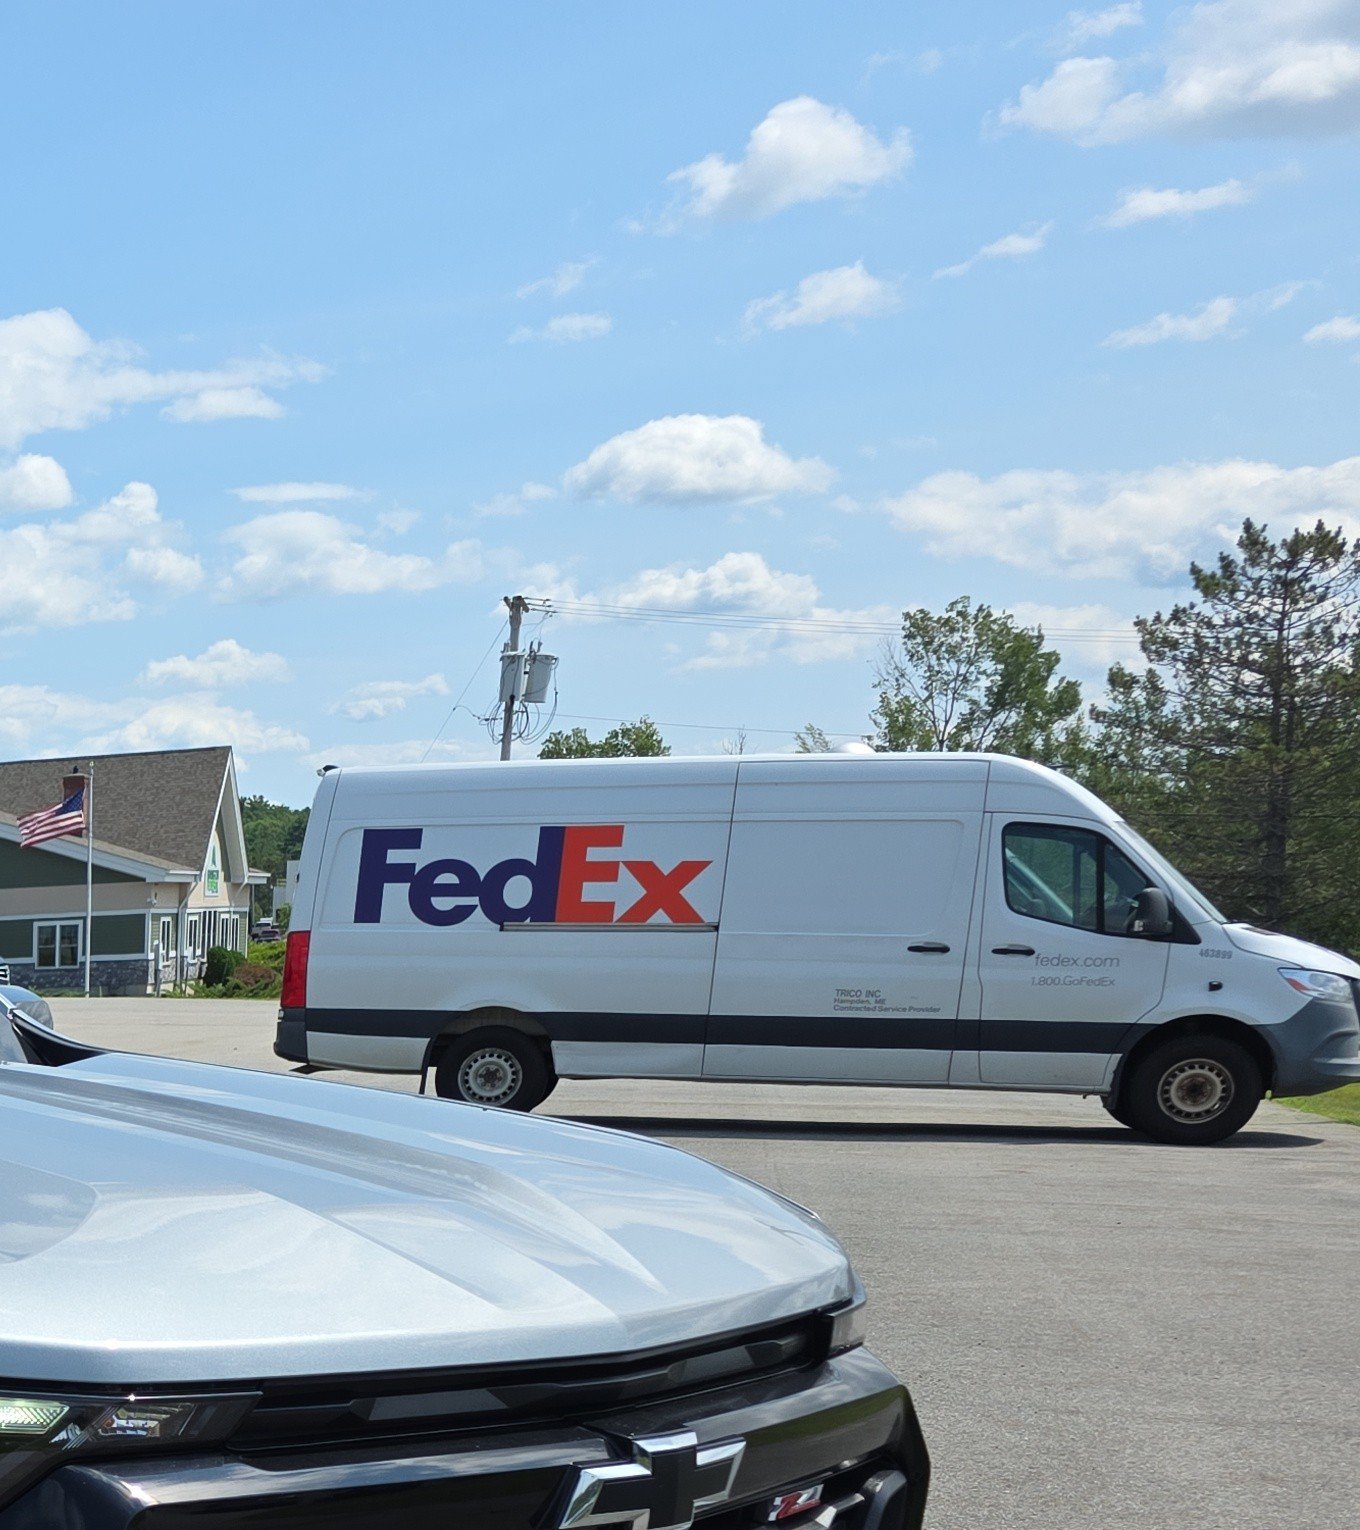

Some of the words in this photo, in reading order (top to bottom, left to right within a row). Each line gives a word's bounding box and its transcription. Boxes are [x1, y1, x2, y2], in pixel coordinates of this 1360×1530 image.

[354, 825, 714, 927] FedEx
[1035, 953, 1120, 968] fedex.com
[1031, 975, 1116, 987] 1.800.GoFedEx
[835, 988, 863, 998] TRICO
[865, 989, 882, 998] INC
[833, 1004, 877, 1012] Contracted
[877, 1005, 908, 1013] Service
